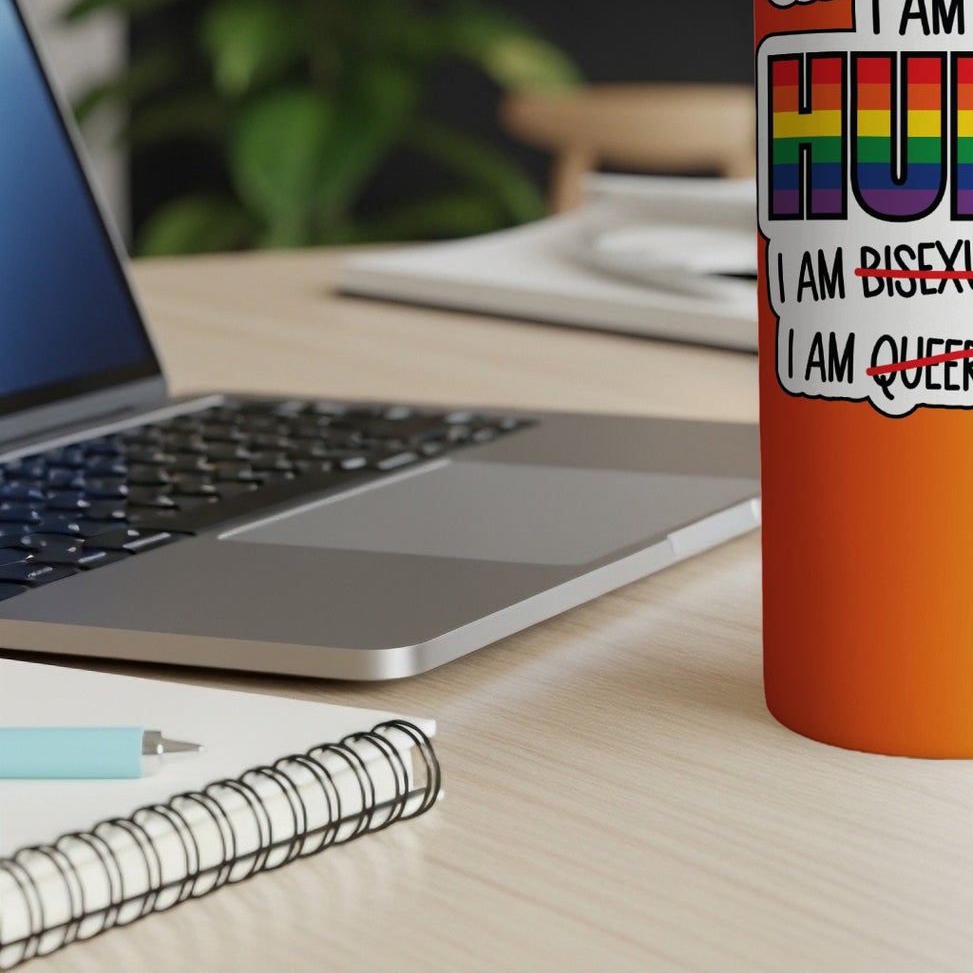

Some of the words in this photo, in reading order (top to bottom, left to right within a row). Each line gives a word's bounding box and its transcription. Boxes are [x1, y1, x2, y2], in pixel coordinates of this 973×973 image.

[777, 252, 786, 304] I
[796, 247, 846, 304] AM
[787, 328, 795, 379] I
[804, 331, 856, 384] AM
